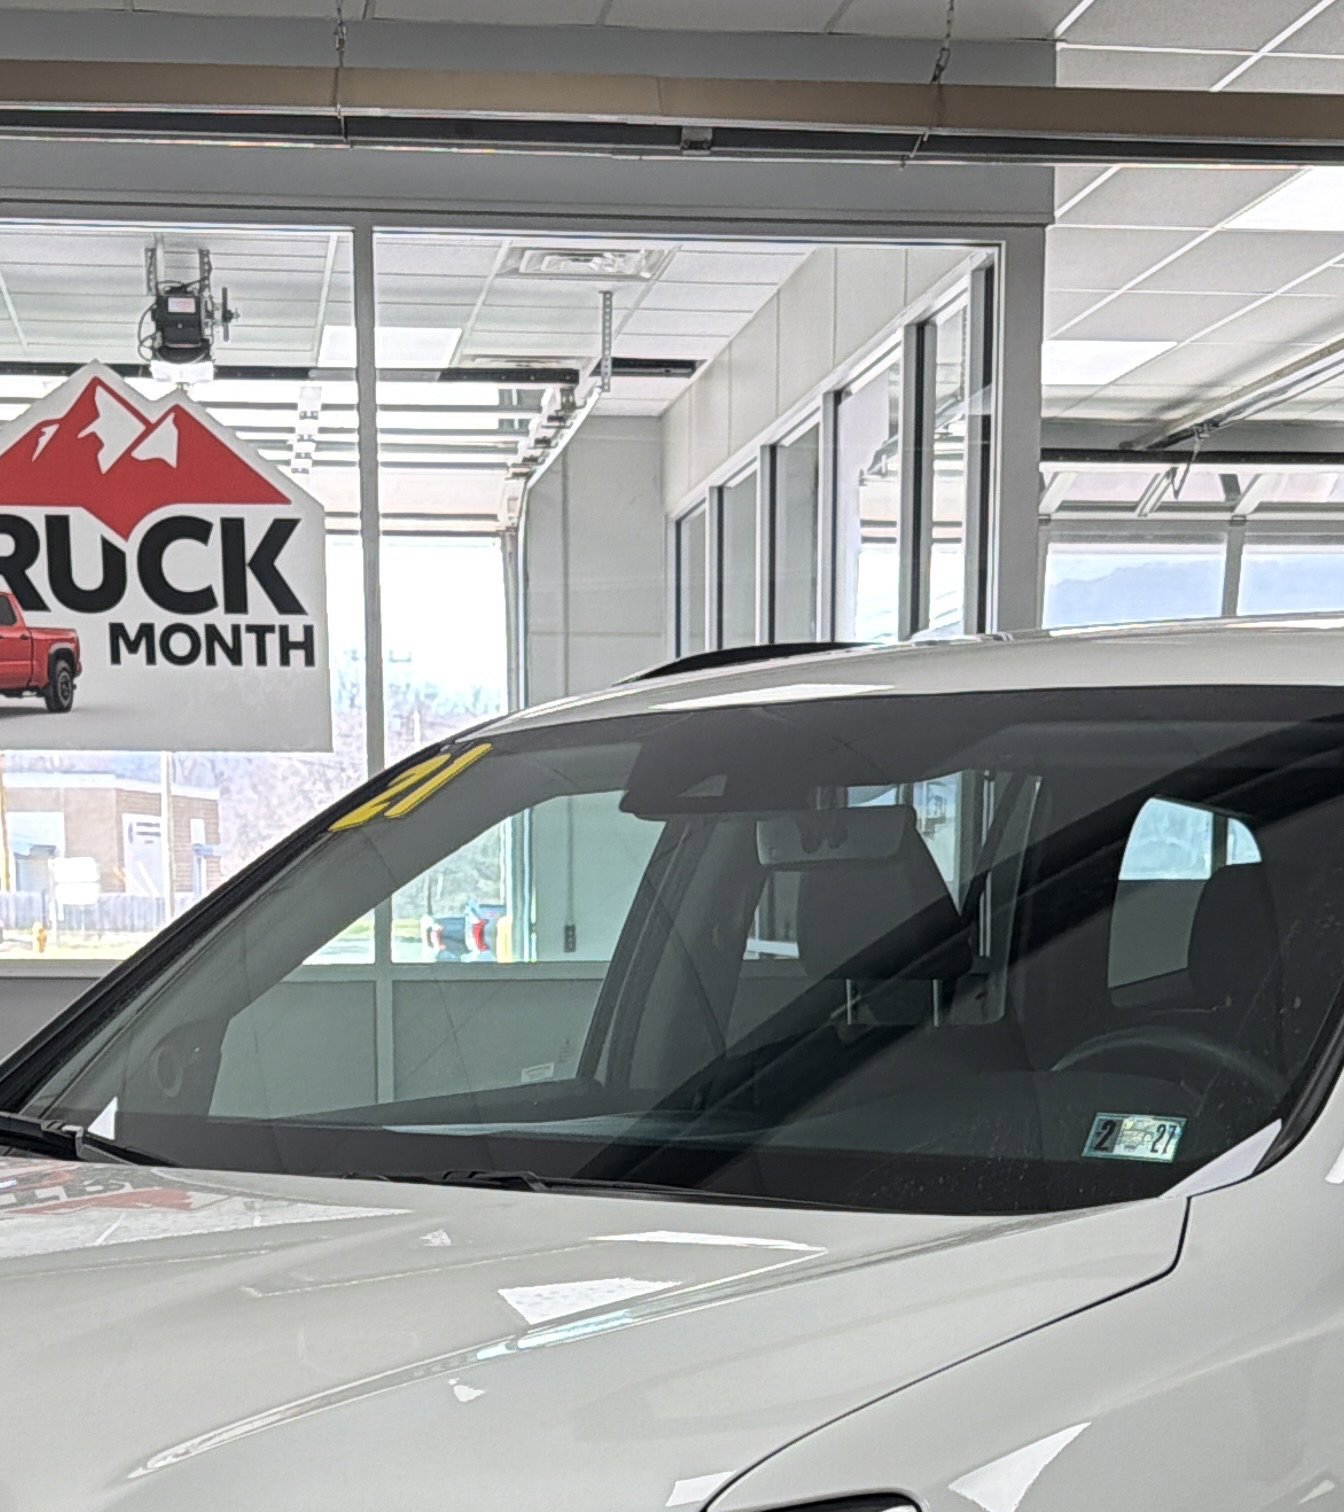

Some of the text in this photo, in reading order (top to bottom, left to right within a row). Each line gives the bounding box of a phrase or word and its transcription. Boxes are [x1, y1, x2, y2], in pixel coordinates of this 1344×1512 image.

[109, 621, 316, 668] MONTH
[1094, 1120, 1116, 1152] 2
[1150, 1123, 1177, 1155] 27
